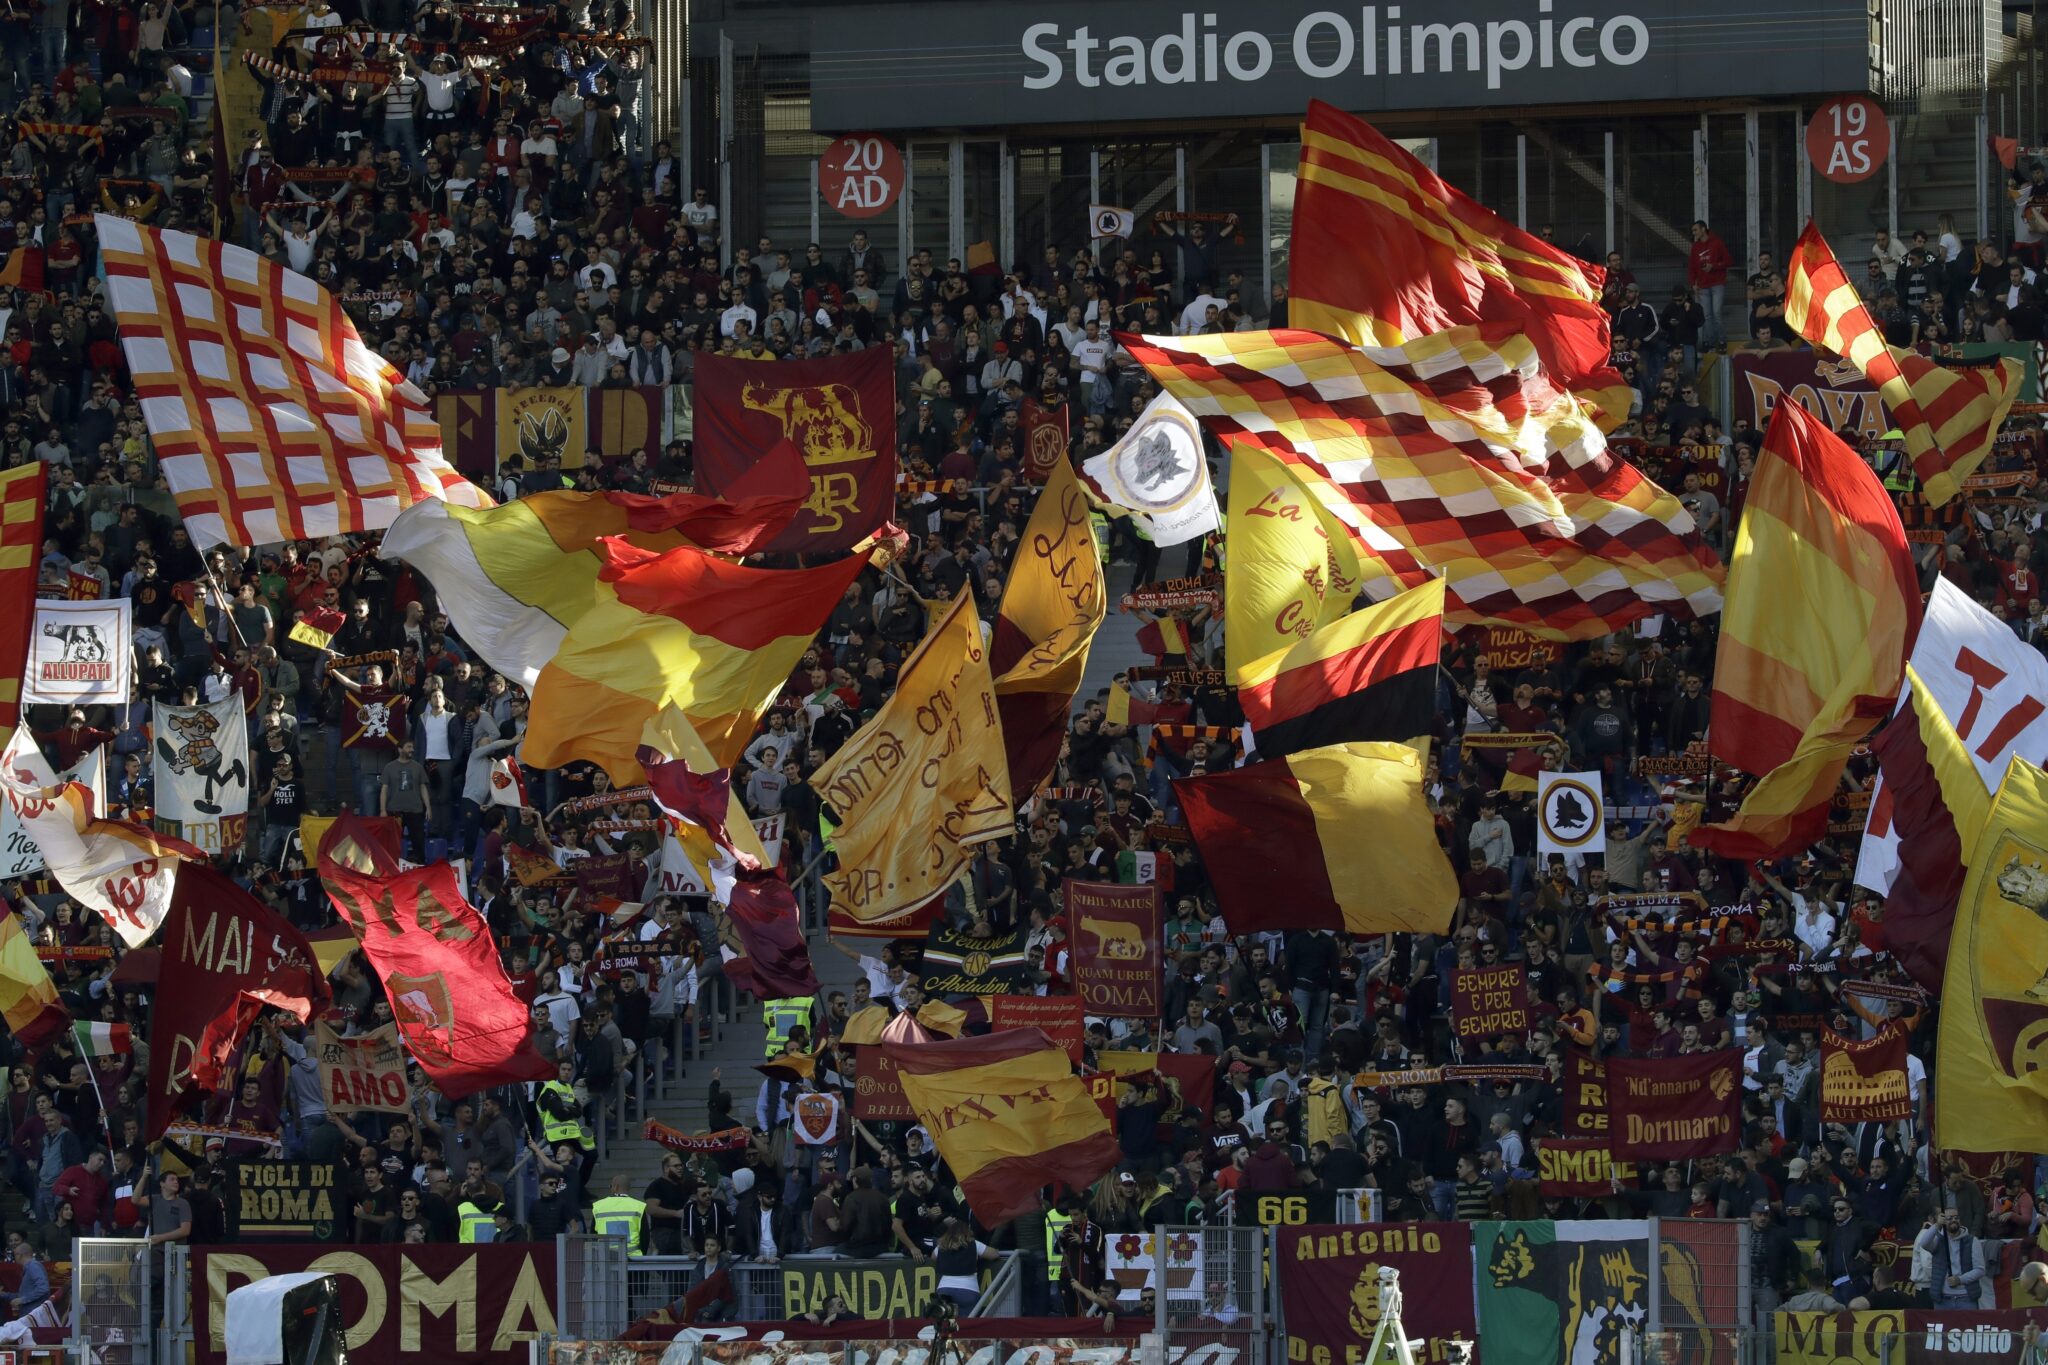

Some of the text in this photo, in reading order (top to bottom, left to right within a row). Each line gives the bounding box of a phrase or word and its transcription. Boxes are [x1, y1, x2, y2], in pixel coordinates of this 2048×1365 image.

[1021, 0, 1650, 90] Stadio Olimpico
[1828, 102, 1866, 136] 19
[843, 137, 883, 171] 20
[1826, 140, 1871, 175] AS
[837, 174, 891, 208] AD
[513, 397, 572, 415] FREEDOM
[1165, 576, 1202, 592] ROMA
[1137, 600, 1165, 608] NON
[1163, 598, 1190, 606] PERDE
[42, 662, 111, 681] ALLUPATI
[587, 792, 621, 805] FORZA
[1111, 899, 1152, 909] MAIUS
[1608, 895, 1681, 908] AS ROMA
[1709, 903, 1753, 917] ROMA
[181, 906, 253, 974] MAI
[618, 944, 672, 953] ROMA
[599, 957, 638, 971] AS ROMA
[1077, 966, 1152, 981] QUAM URBE
[1457, 968, 1520, 993] SEMPRE
[1079, 983, 1154, 1006] ROMA
[1472, 990, 1512, 1009] E PER
[1460, 1011, 1527, 1036] SEMPRE!
[1822, 1027, 1900, 1051] AUT ROMA
[332, 1068, 406, 1106] AMO
[1379, 1070, 1440, 1084] AS ROMA
[1824, 1102, 1909, 1120] AUT NIHIL
[667, 1134, 722, 1148] ROMA
[1213, 1134, 1240, 1148] VANS
[239, 1164, 334, 1187] FIGLI DI
[240, 1188, 335, 1221] ROMA
[1257, 1196, 1308, 1226] 66
[1297, 1224, 1441, 1261] Antonio
[207, 1248, 560, 1352] ROMA
[1780, 1312, 1900, 1356] MIO
[1925, 1323, 2012, 1354] il solito
[1287, 1333, 1332, 1365] De
